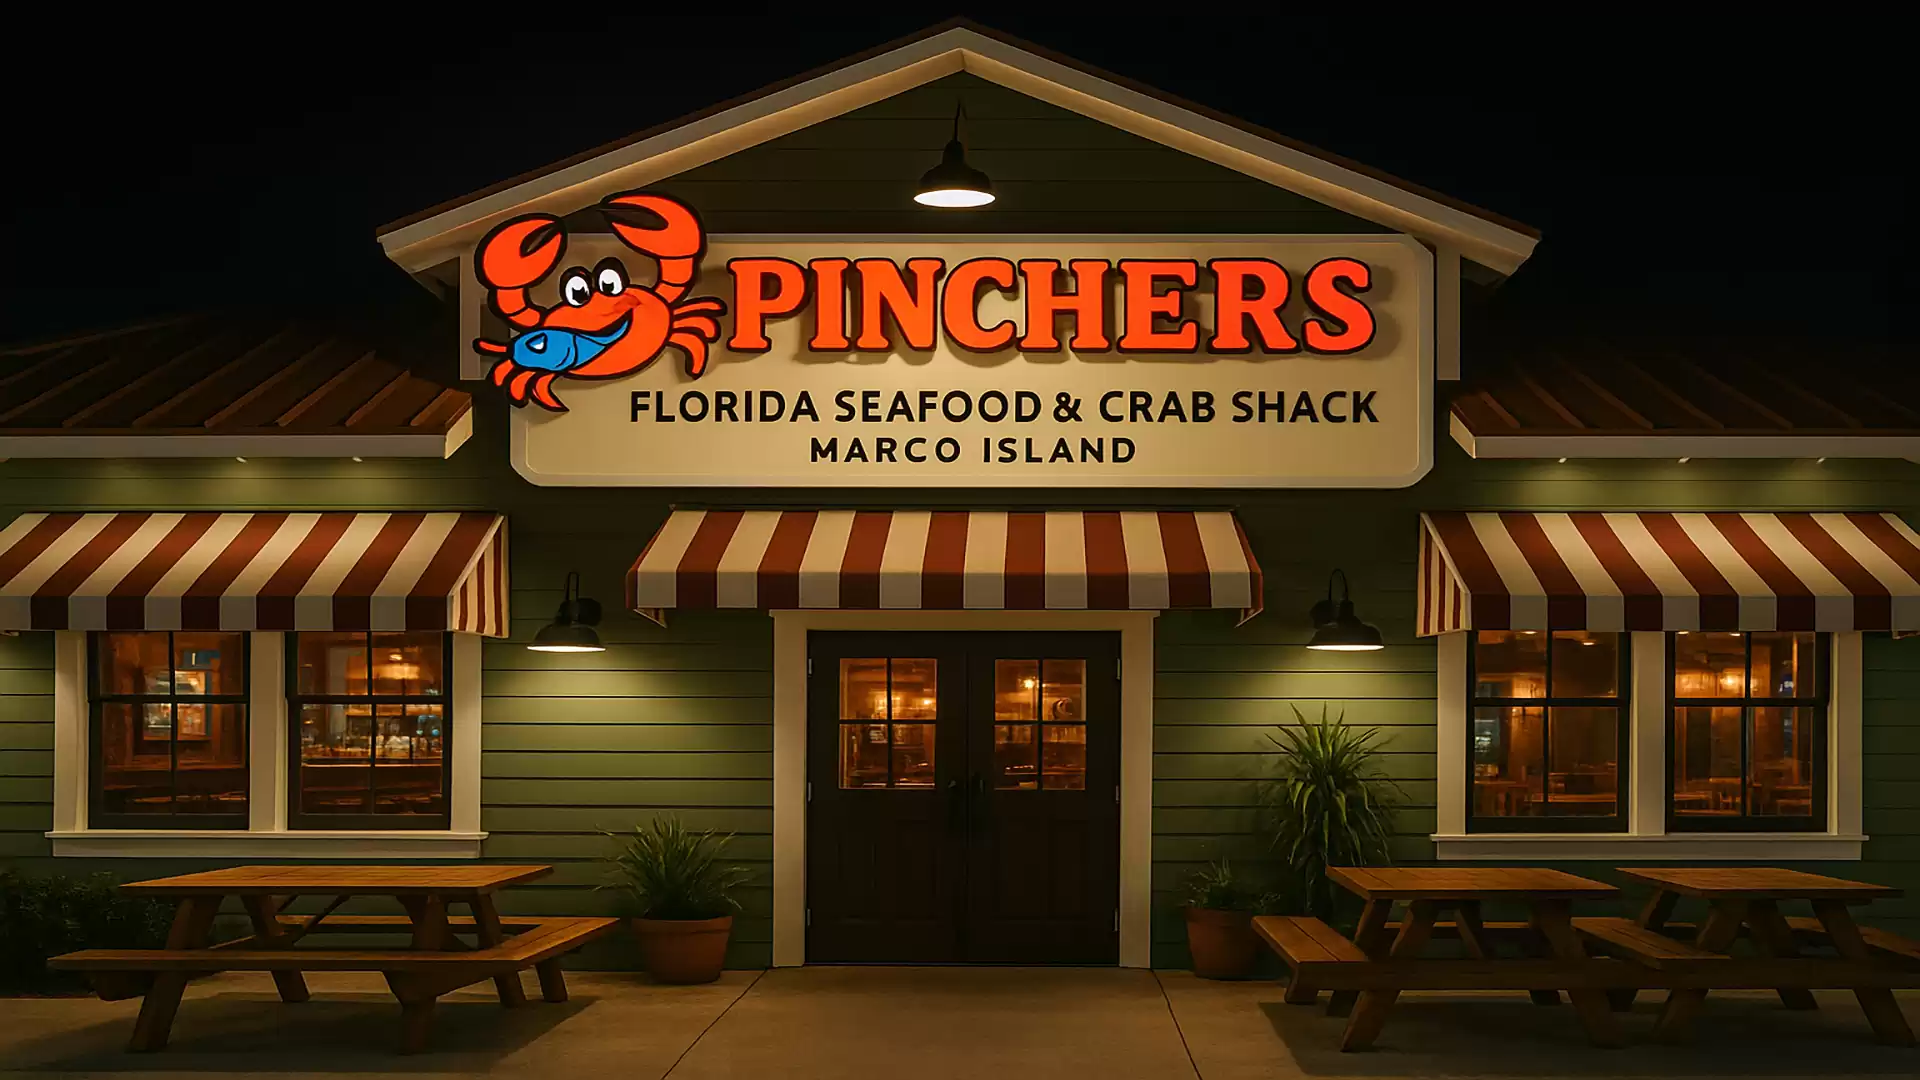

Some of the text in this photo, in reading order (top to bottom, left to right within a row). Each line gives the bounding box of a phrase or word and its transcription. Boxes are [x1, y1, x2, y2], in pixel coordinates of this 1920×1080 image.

[727, 257, 1376, 354] PINCHERS
[630, 390, 1380, 424] FLORIDA SEAFOOD & CRAB SHACK
[810, 437, 1136, 463] MARCO ISLAND
